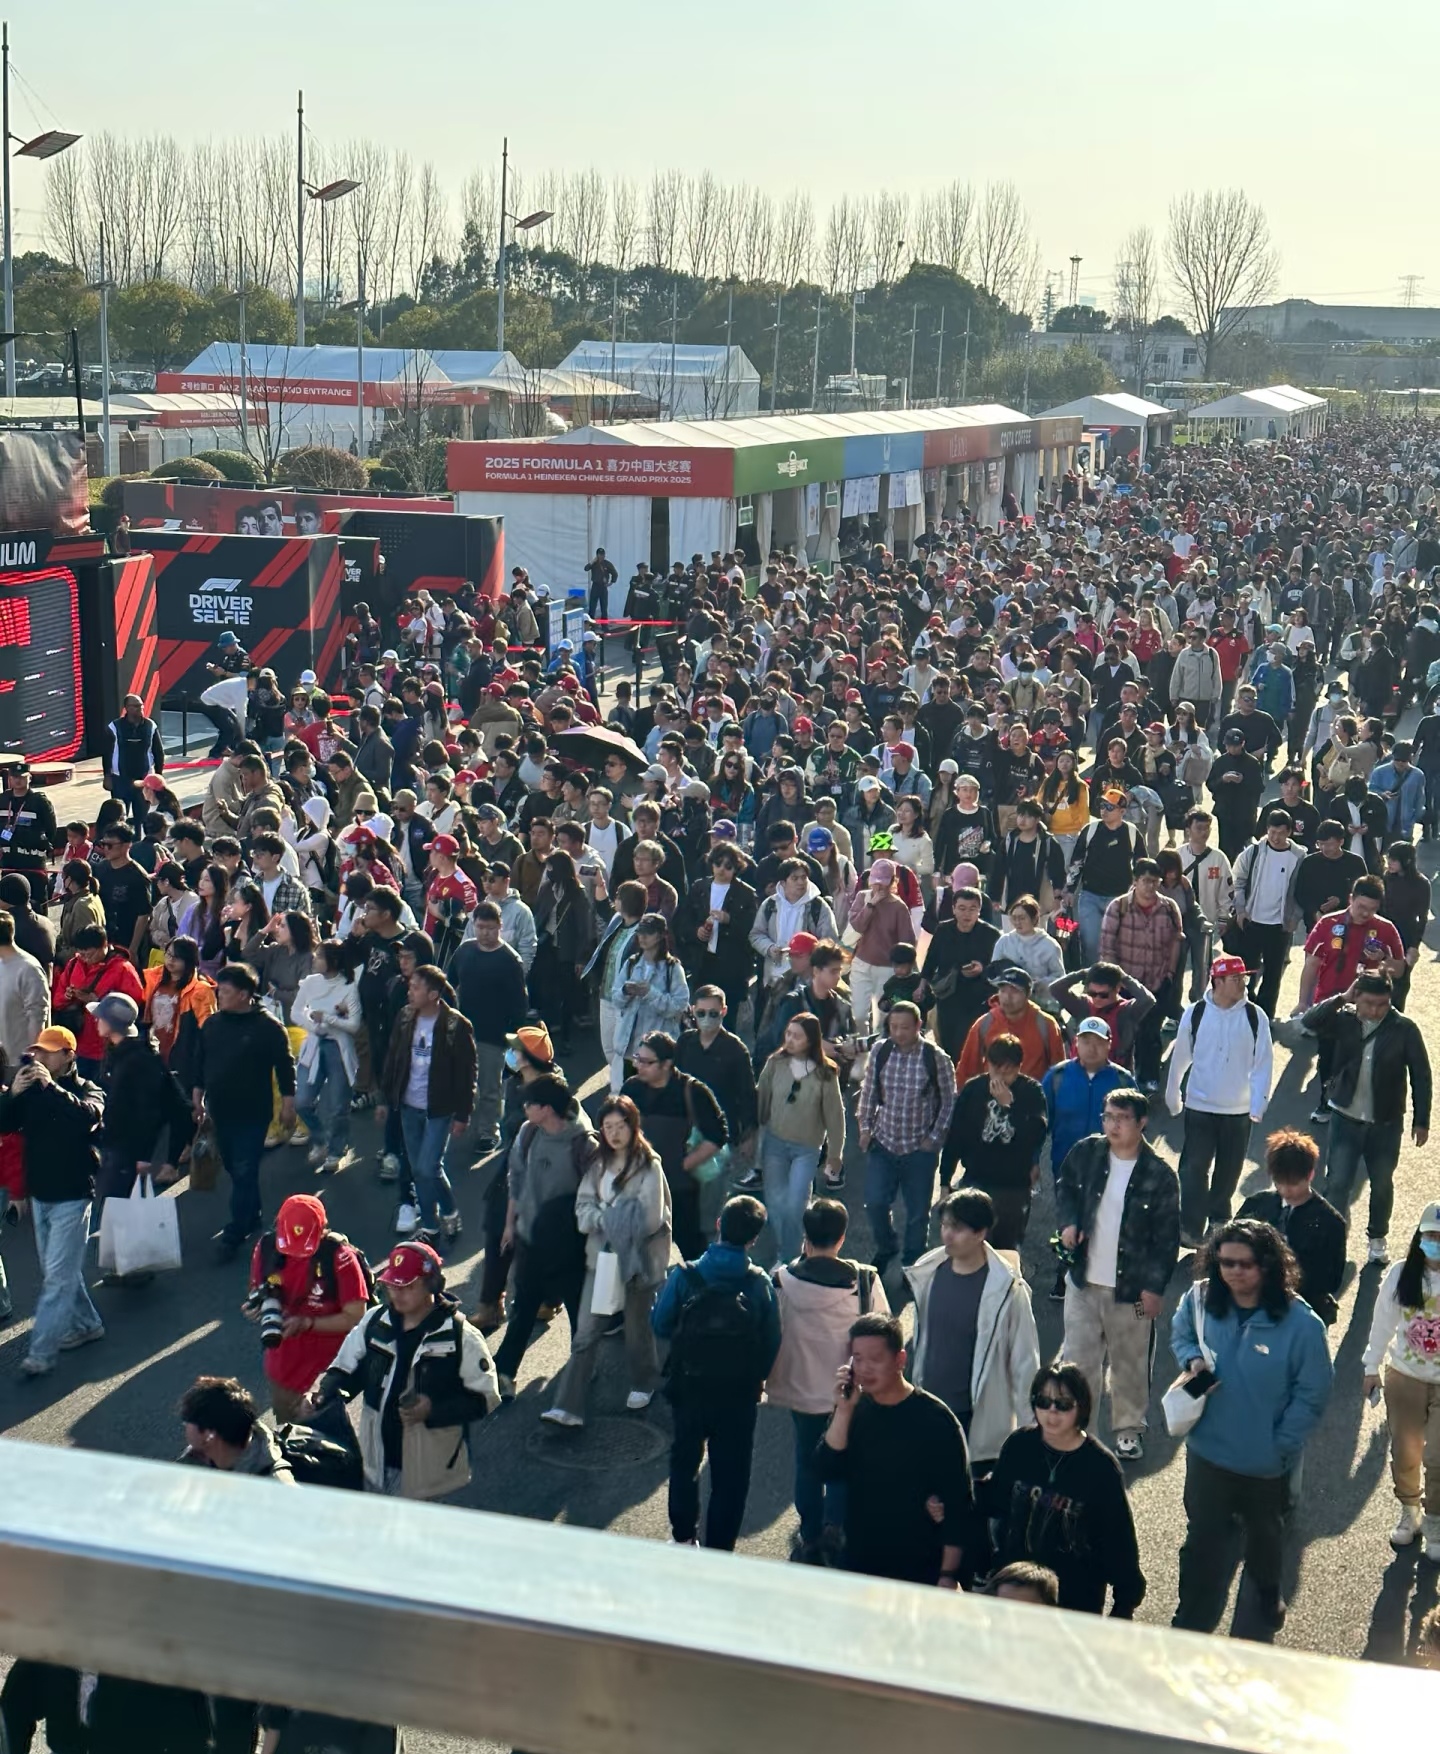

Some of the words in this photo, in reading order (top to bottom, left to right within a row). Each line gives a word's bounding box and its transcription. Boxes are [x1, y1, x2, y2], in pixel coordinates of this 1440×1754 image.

[303, 387, 352, 397] ENTRANCE
[485, 457, 520, 469] 2025
[522, 458, 593, 470] FORMULA
[595, 459, 603, 471] 1
[607, 459, 692, 473] 喜力中国大奖赛
[485, 472, 526, 480] FORMULA
[534, 473, 577, 481] HEINEKEN
[578, 474, 615, 482] CHINESE
[616, 475, 648, 483] GRAND
[670, 476, 692, 484] 2025
[189, 593, 253, 611] DRIVER
[193, 608, 250, 625] SELFIE
